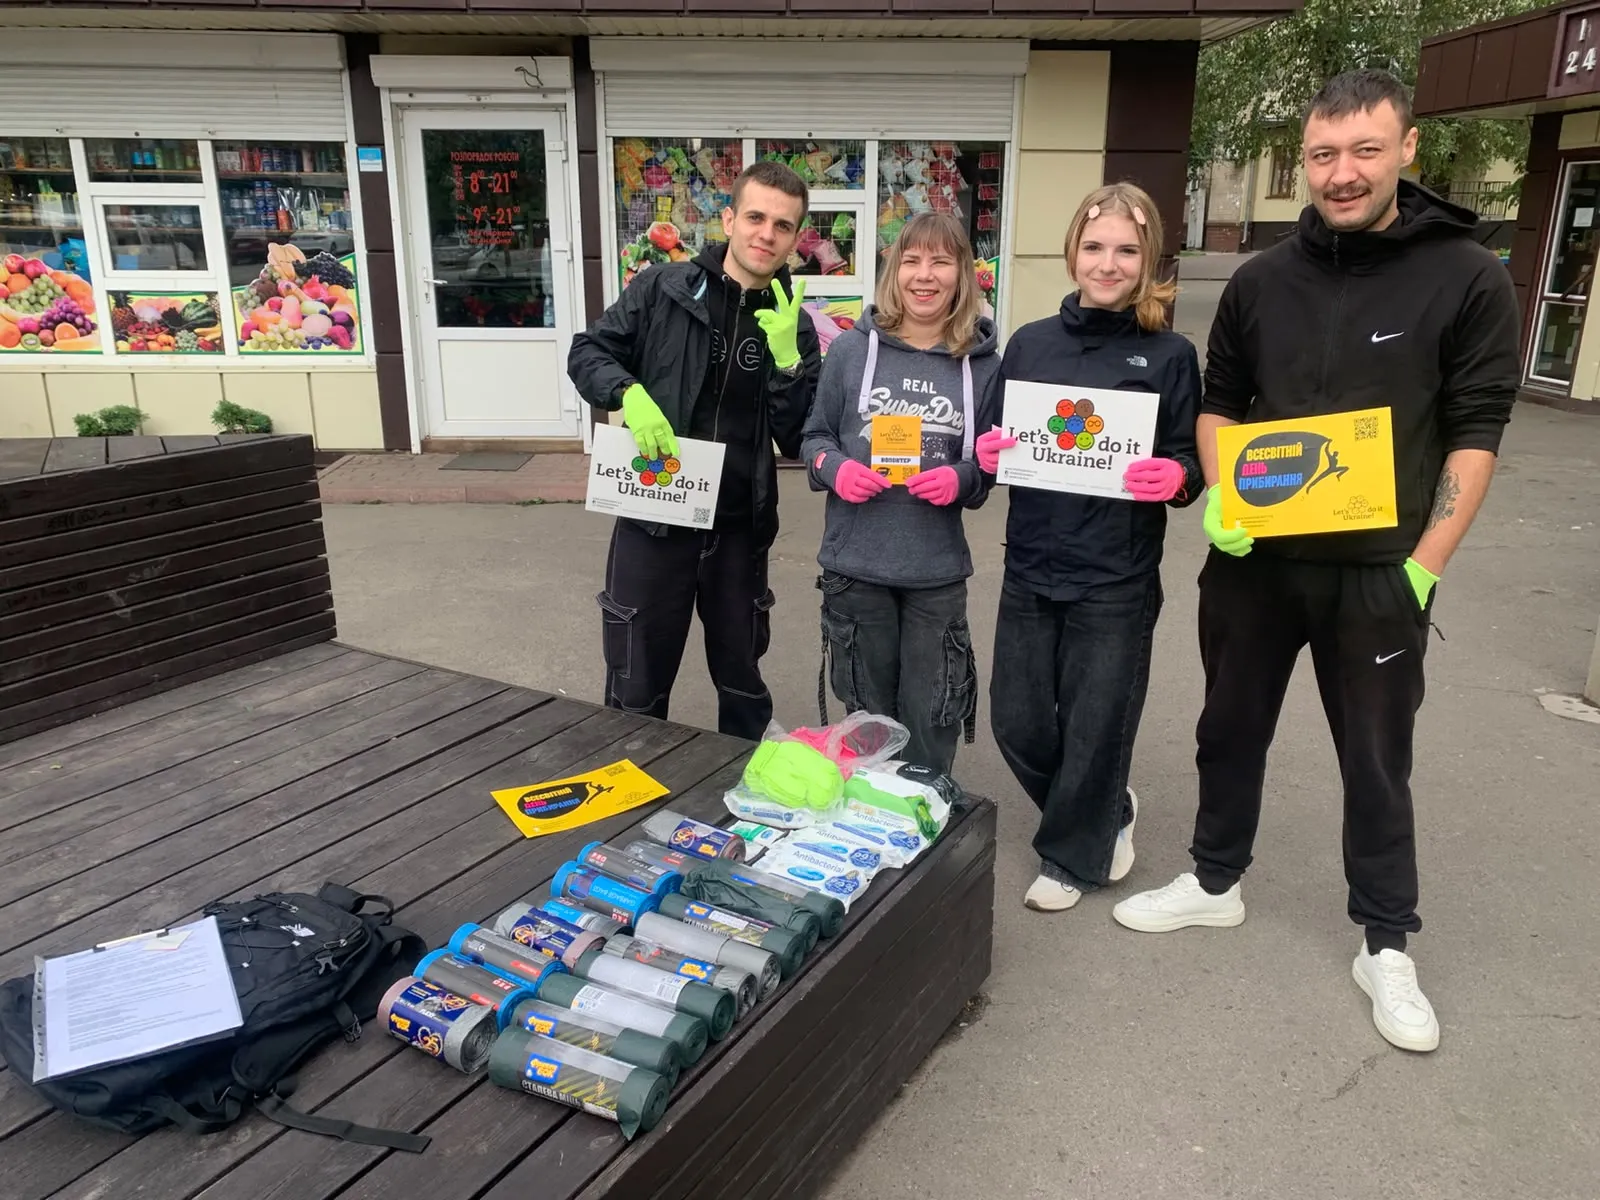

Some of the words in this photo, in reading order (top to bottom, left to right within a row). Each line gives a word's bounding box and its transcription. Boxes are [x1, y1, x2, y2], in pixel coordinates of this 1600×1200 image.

[902, 378, 937, 394] REAL
[1009, 427, 1049, 445] Let's
[1098, 436, 1122, 453] do
[1126, 438, 1141, 455] it
[1032, 446, 1113, 470] Ukraine!
[1246, 441, 1303, 462] ВСЕСВІТНІЙ
[596, 463, 634, 481] Let's
[675, 475, 695, 490] do
[698, 478, 711, 492] it
[1241, 462, 1268, 476] ДЕНЬ
[1238, 473, 1303, 490] ПРИБИРАННЯ
[617, 481, 688, 504] Ukraine!
[523, 786, 573, 803] ВСЕСВІТНІЙ
[523, 799, 547, 809] ДЕНЬ
[524, 797, 581, 815] ПРИБИРАННЯ
[853, 811, 905, 829] Antibacterial
[793, 850, 845, 873] Antibacterial
[521, 1078, 558, 1098] СТАЛЕВА
